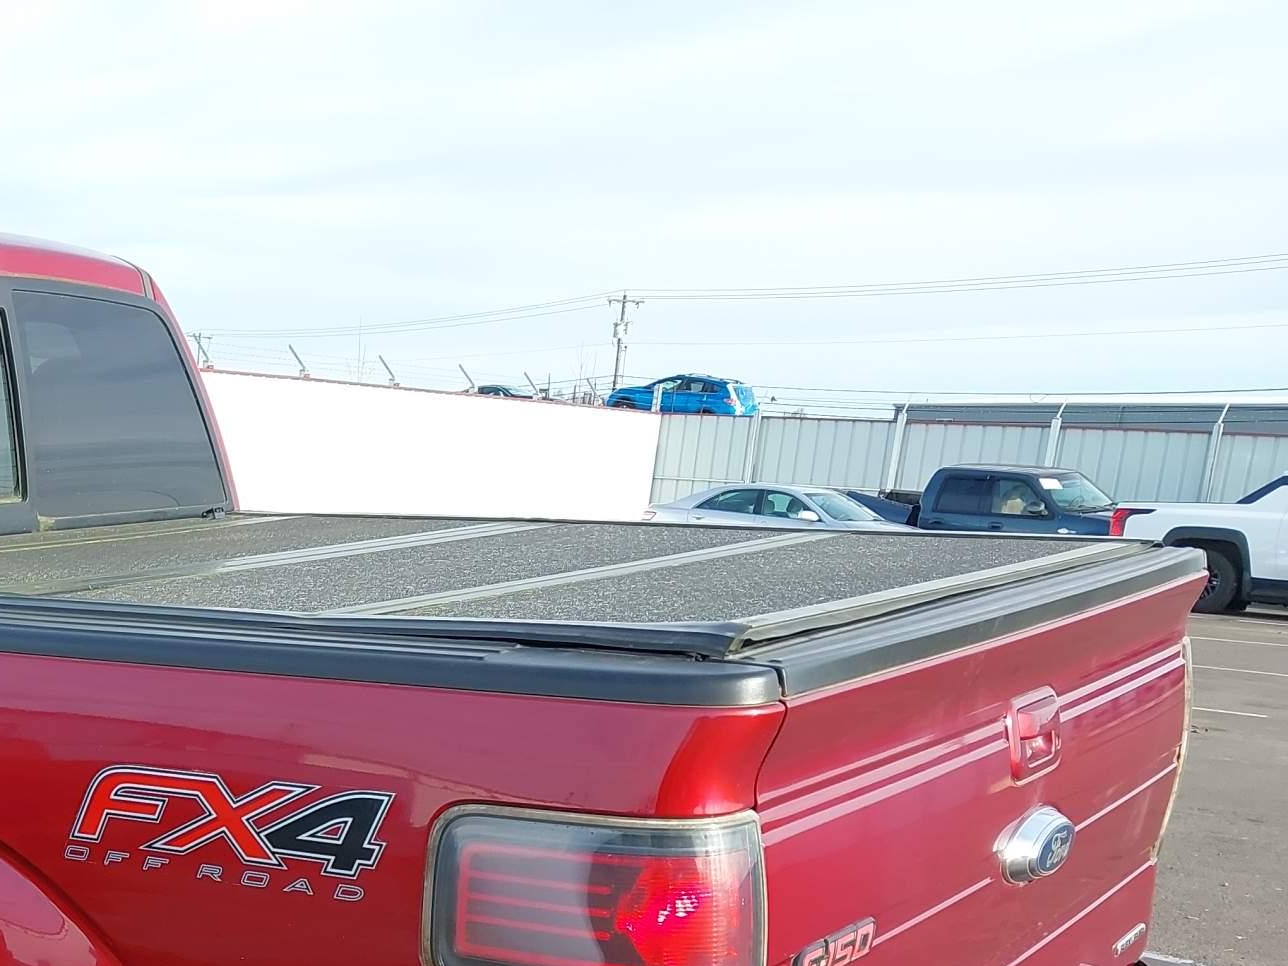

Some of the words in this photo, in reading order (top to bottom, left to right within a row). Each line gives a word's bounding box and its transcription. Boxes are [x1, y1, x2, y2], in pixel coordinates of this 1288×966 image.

[69, 764, 397, 880] FX4
[64, 844, 169, 871] OFF
[196, 863, 365, 902] ROAD
